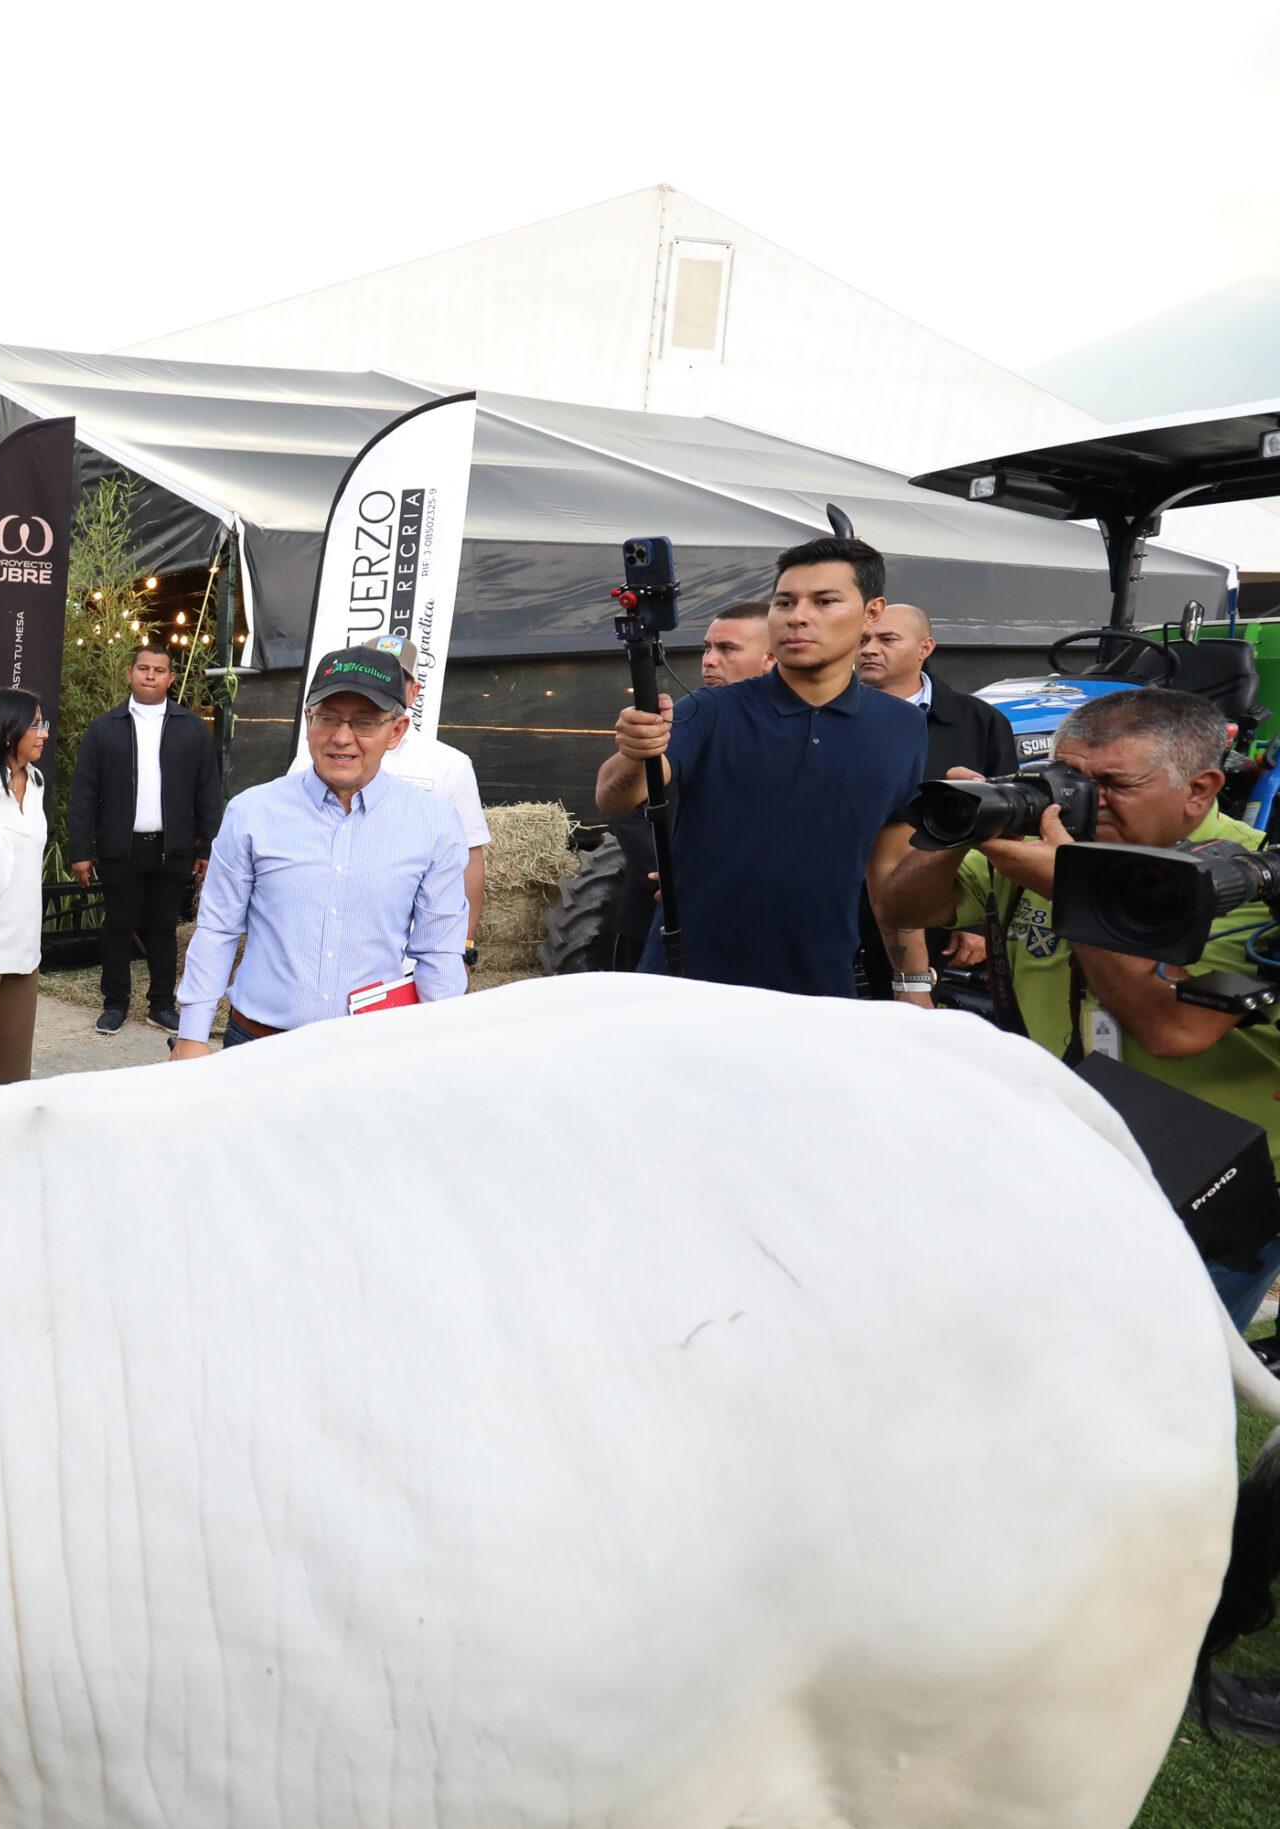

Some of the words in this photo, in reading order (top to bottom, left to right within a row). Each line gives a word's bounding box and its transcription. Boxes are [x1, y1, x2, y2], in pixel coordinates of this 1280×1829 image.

[397, 492, 422, 591] RECRIA
[15, 611, 25, 643] MESA
[14, 644, 23, 660] TU
[12, 661, 22, 689] ASTA
[1191, 1167, 1238, 1211] ProHD
